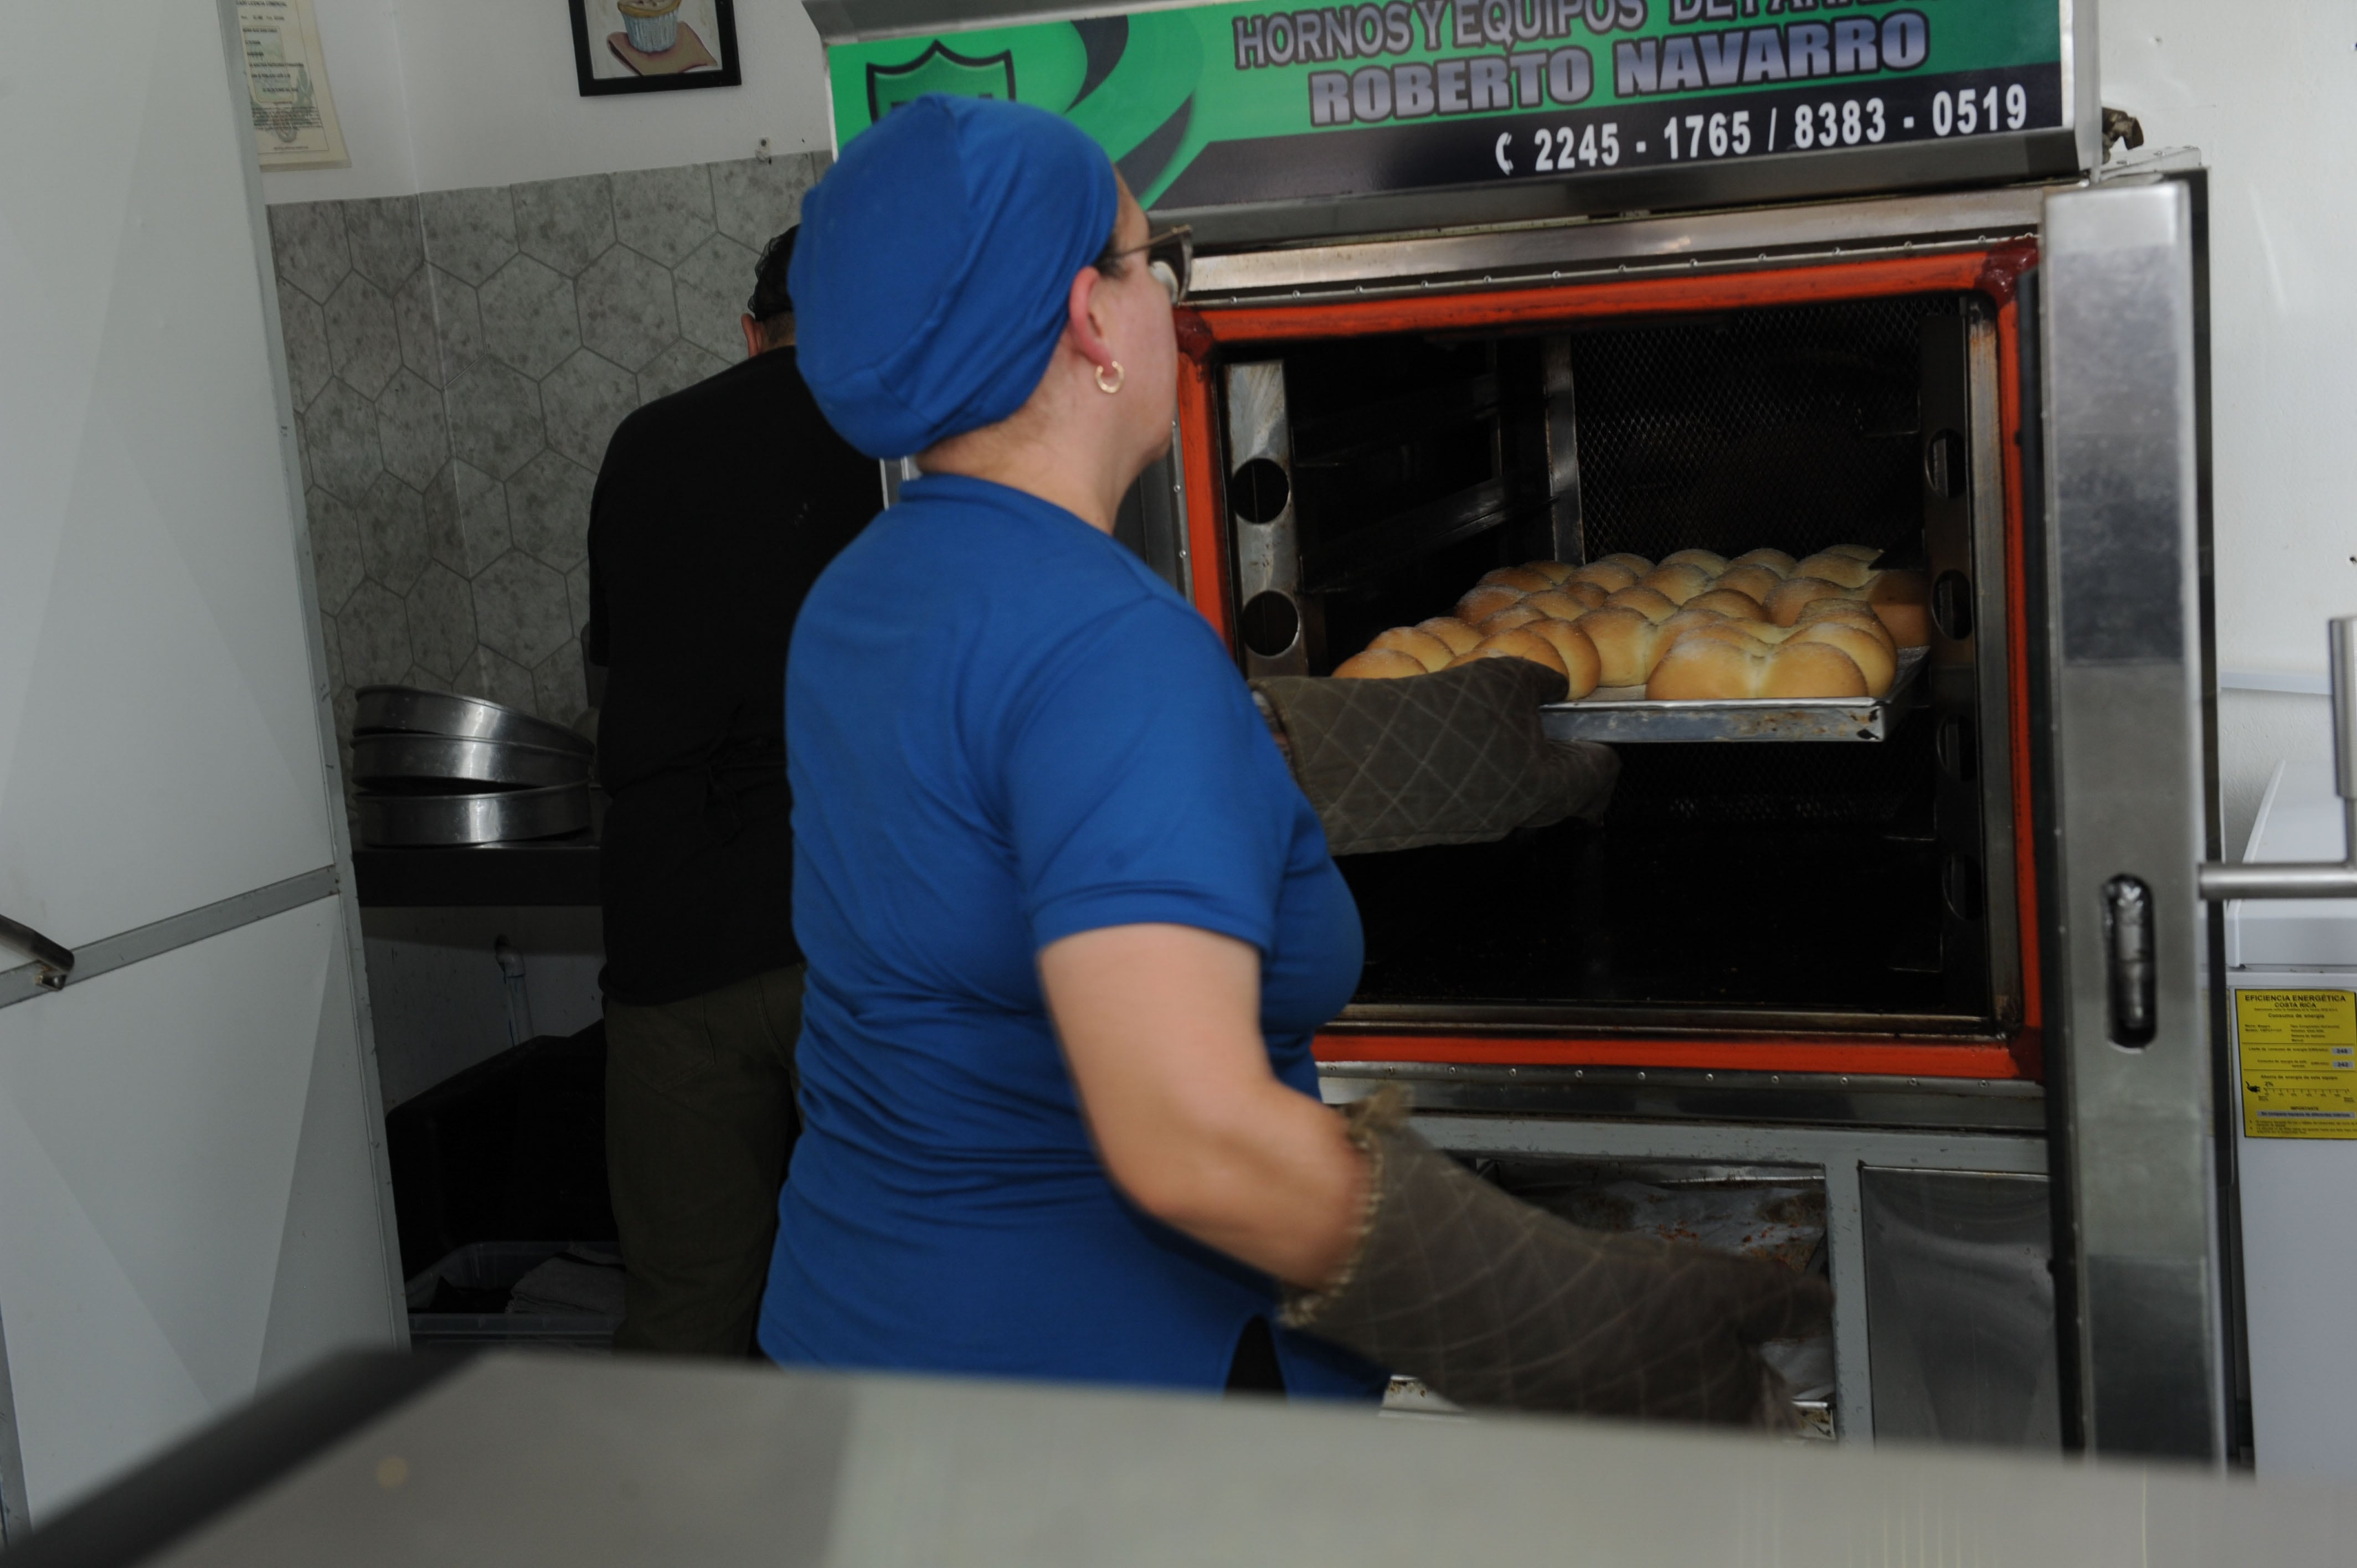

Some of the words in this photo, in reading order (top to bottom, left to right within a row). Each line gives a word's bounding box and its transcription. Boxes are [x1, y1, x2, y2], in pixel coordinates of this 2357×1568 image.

[1233, 2, 1413, 69] HORNOS
[1411, 0, 1446, 51] Y
[1452, 0, 1648, 53] EQUIPOS
[1308, 45, 1594, 127] ROBERTO
[1612, 9, 1930, 97] NAVARRO
[1534, 123, 1619, 172] 2245
[1664, 111, 1751, 159] 1765
[1795, 97, 1886, 149] 8383
[1932, 84, 2027, 137] 0519
[2292, 993, 2346, 1002] ENERGÉTICA
